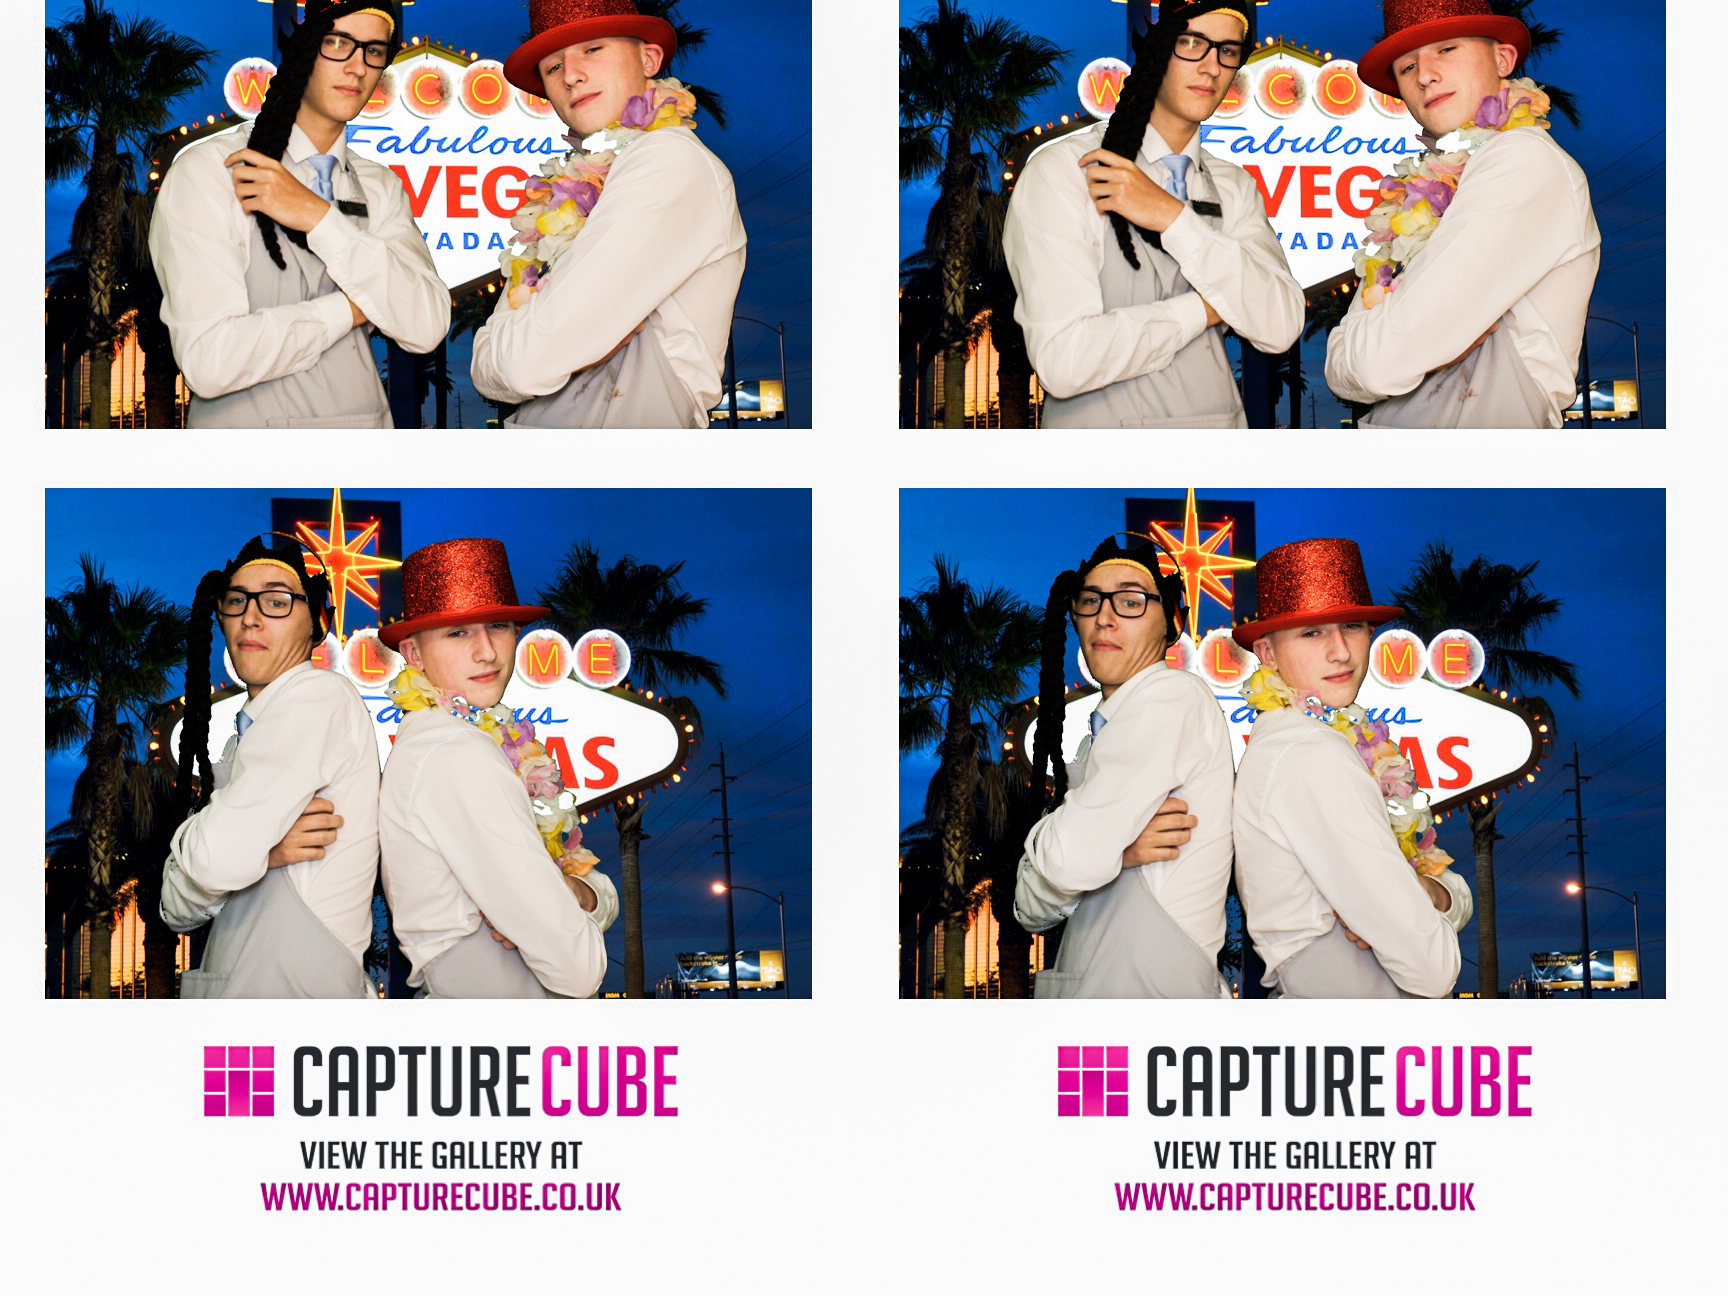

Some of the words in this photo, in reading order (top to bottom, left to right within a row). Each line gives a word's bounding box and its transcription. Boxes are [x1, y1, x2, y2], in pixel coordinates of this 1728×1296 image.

[389, 164, 532, 219] VEG
[1243, 164, 1386, 219] VEG
[423, 231, 505, 250] ADA
[1277, 231, 1359, 250] ADA
